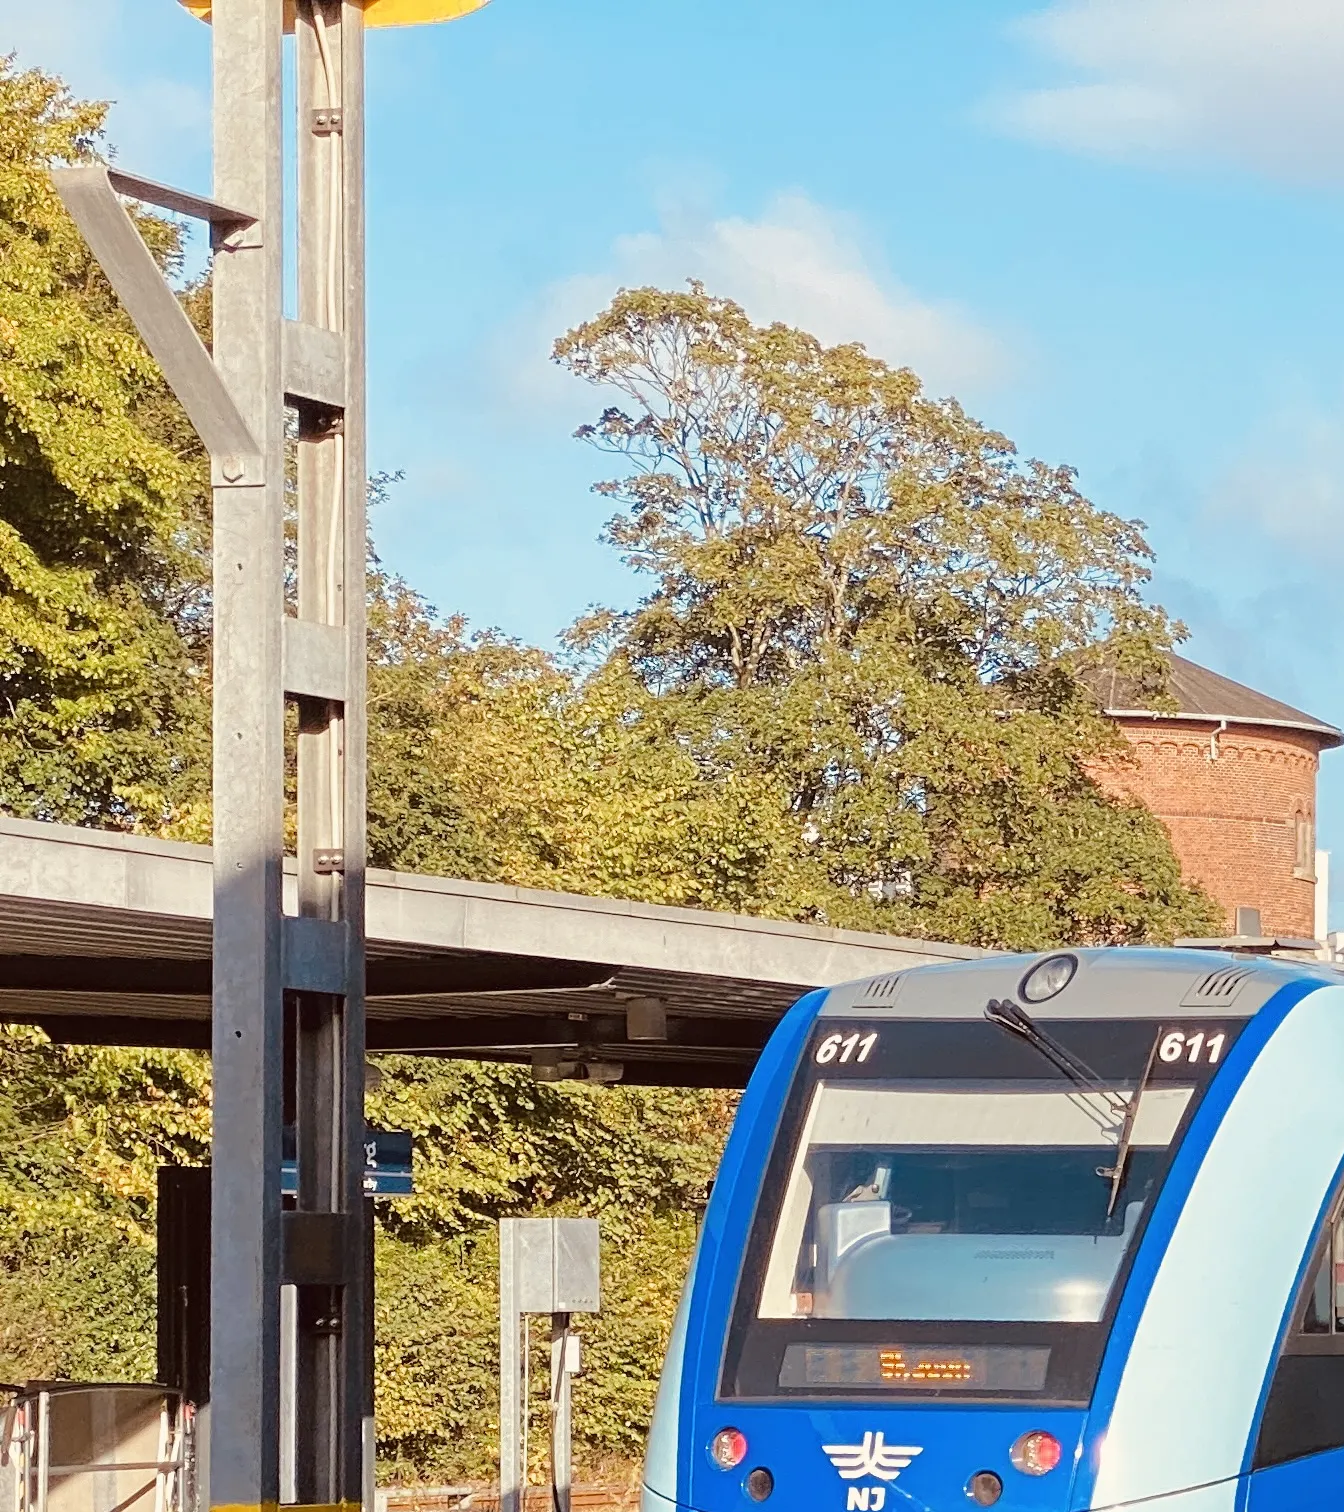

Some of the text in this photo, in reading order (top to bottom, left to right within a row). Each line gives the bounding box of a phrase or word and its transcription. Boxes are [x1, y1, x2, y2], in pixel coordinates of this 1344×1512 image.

[816, 1033, 878, 1064] 611
[1160, 1032, 1225, 1063] 611
[846, 1486, 886, 1512] NJ
